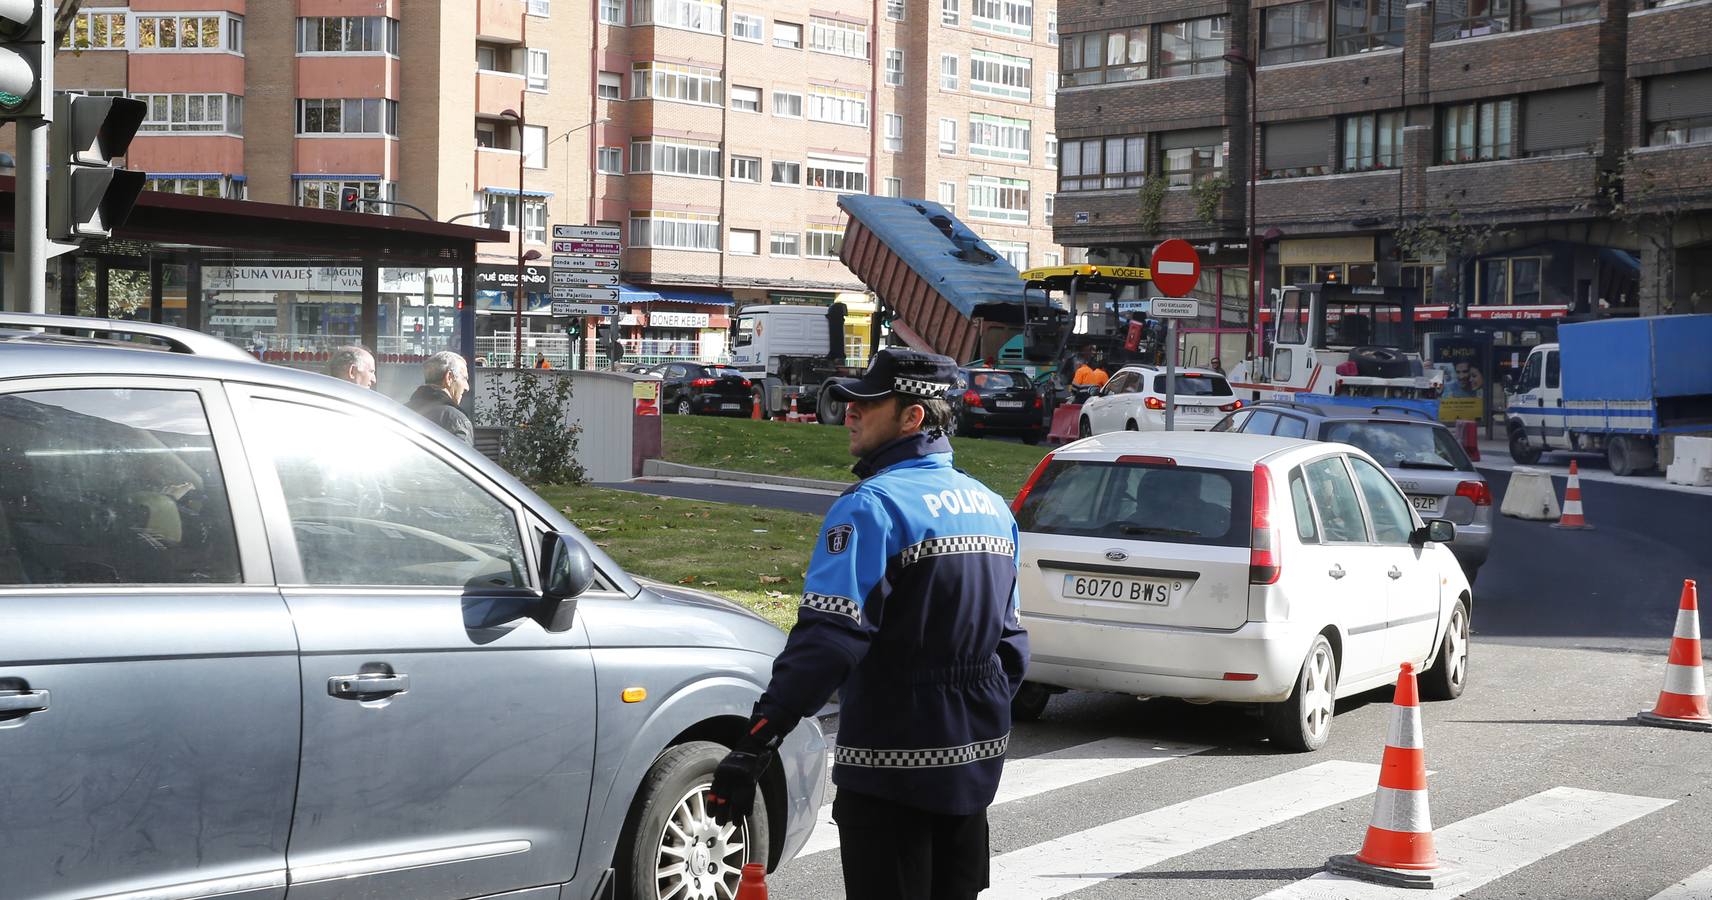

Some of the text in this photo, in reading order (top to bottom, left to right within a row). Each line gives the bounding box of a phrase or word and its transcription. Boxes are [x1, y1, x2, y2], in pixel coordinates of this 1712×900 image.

[218, 269, 313, 280] LAGUNA VIAJES
[326, 267, 362, 277] LAGUN
[681, 316, 707, 326] KEBAB
[1413, 497, 1435, 509] GZP
[1075, 578, 1167, 603] 6070 BWS
